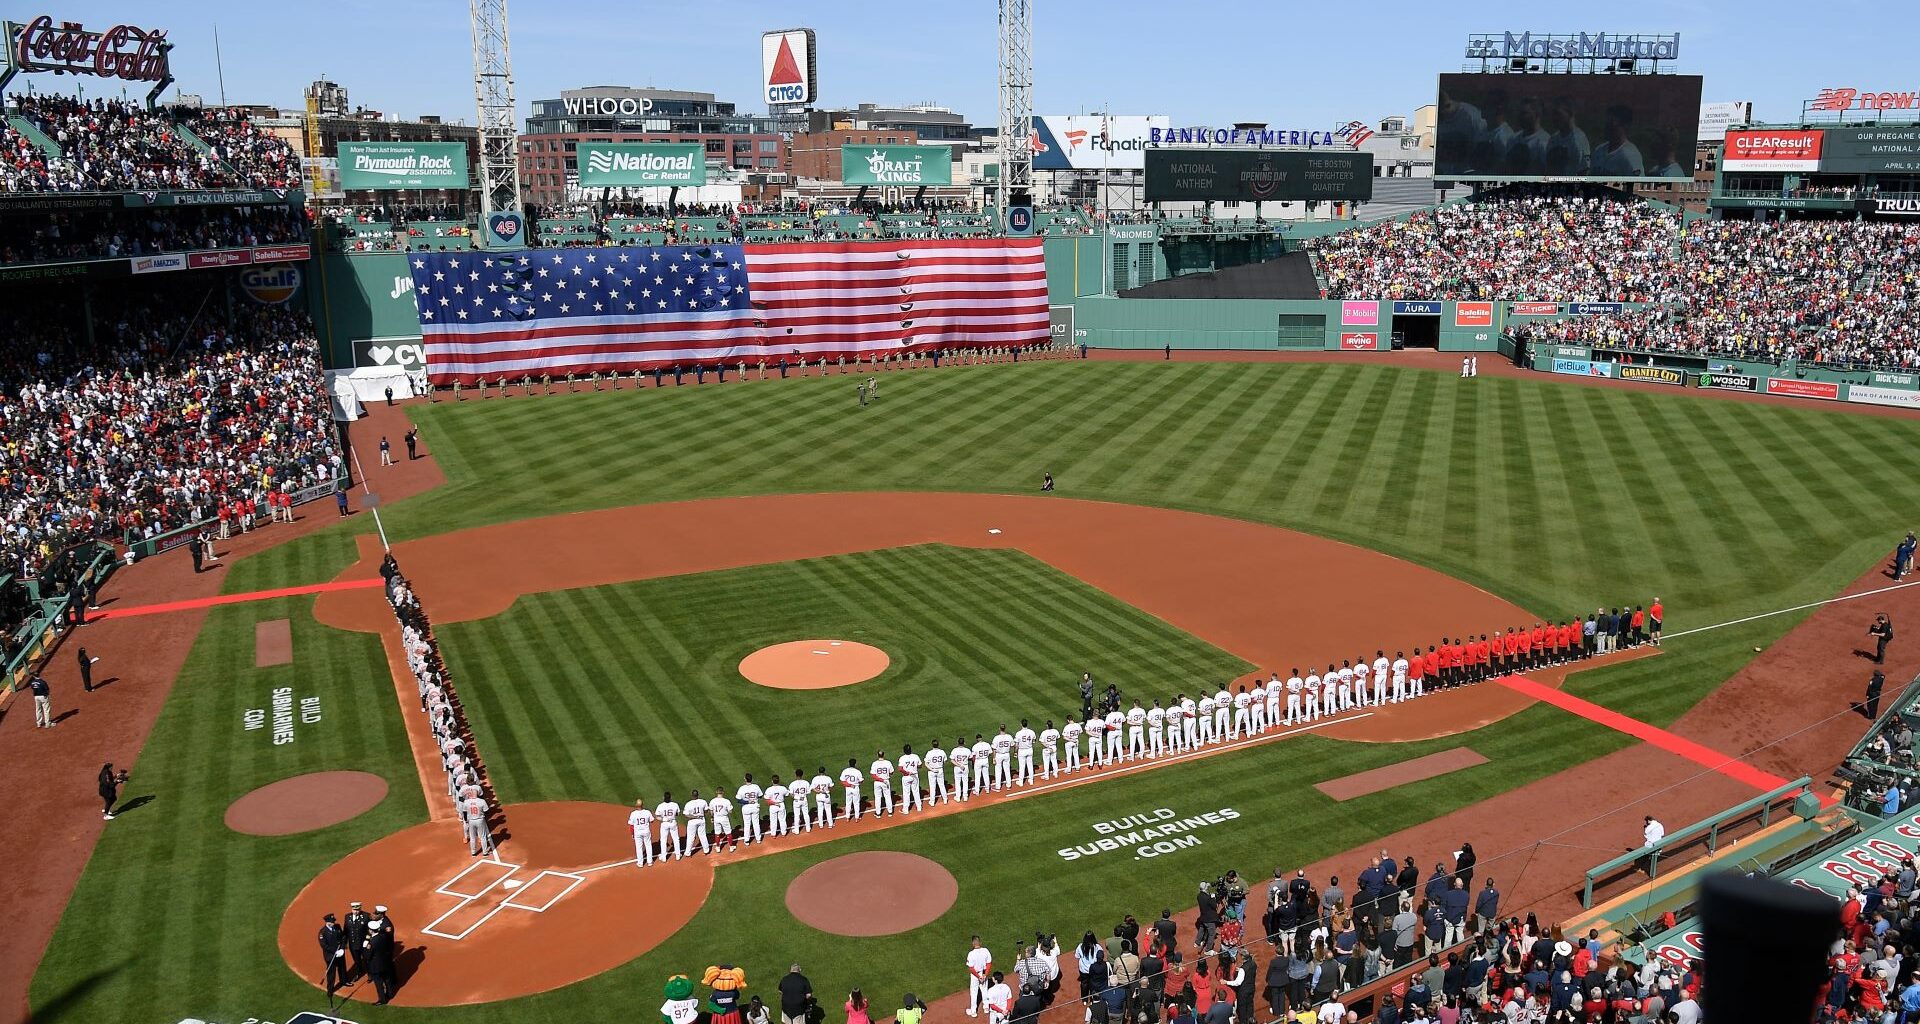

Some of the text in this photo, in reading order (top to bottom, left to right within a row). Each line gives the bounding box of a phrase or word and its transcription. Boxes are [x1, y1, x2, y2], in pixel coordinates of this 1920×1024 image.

[1504, 30, 1681, 60] MassMutual
[768, 85, 804, 101] CITGO
[563, 97, 653, 115] WHOOP
[1860, 91, 1915, 110] new
[1091, 134, 1156, 151] Fanatic
[1151, 128, 1333, 146] BANK OF AMERICA
[1736, 137, 1813, 148] CLEAResult
[355, 155, 451, 171] Plymouth Rock
[1308, 159, 1352, 168] THE BOSTON
[1170, 164, 1217, 174] NATIONAL
[642, 171, 691, 180] Car Rental
[876, 172, 922, 182] KINGS
[1240, 171, 1288, 182] OPENING DAY
[1175, 178, 1213, 189] ANTHEM
[1312, 183, 1346, 192] QUARTET
[186, 193, 263, 204] BLACK LIVES MATTER
[1116, 231, 1153, 239] ABIOMED
[255, 251, 283, 260] Safelite
[153, 259, 180, 268] AMAZING
[242, 271, 297, 288] Gulf
[1352, 308, 1376, 317] Mobile
[395, 344, 427, 365] CV
[1556, 361, 1586, 372] jetBlue
[1622, 368, 1660, 378] GRANITE
[1660, 370, 1681, 382] CITY
[1712, 375, 1750, 386] wasabi
[272, 687, 294, 745] SUBMARINES
[301, 697, 322, 724] BUILD
[1092, 808, 1176, 834] BUILD
[1057, 808, 1241, 861] SUBMARINES
[1134, 834, 1203, 860] .COM
[675, 1008, 689, 1018] 97
